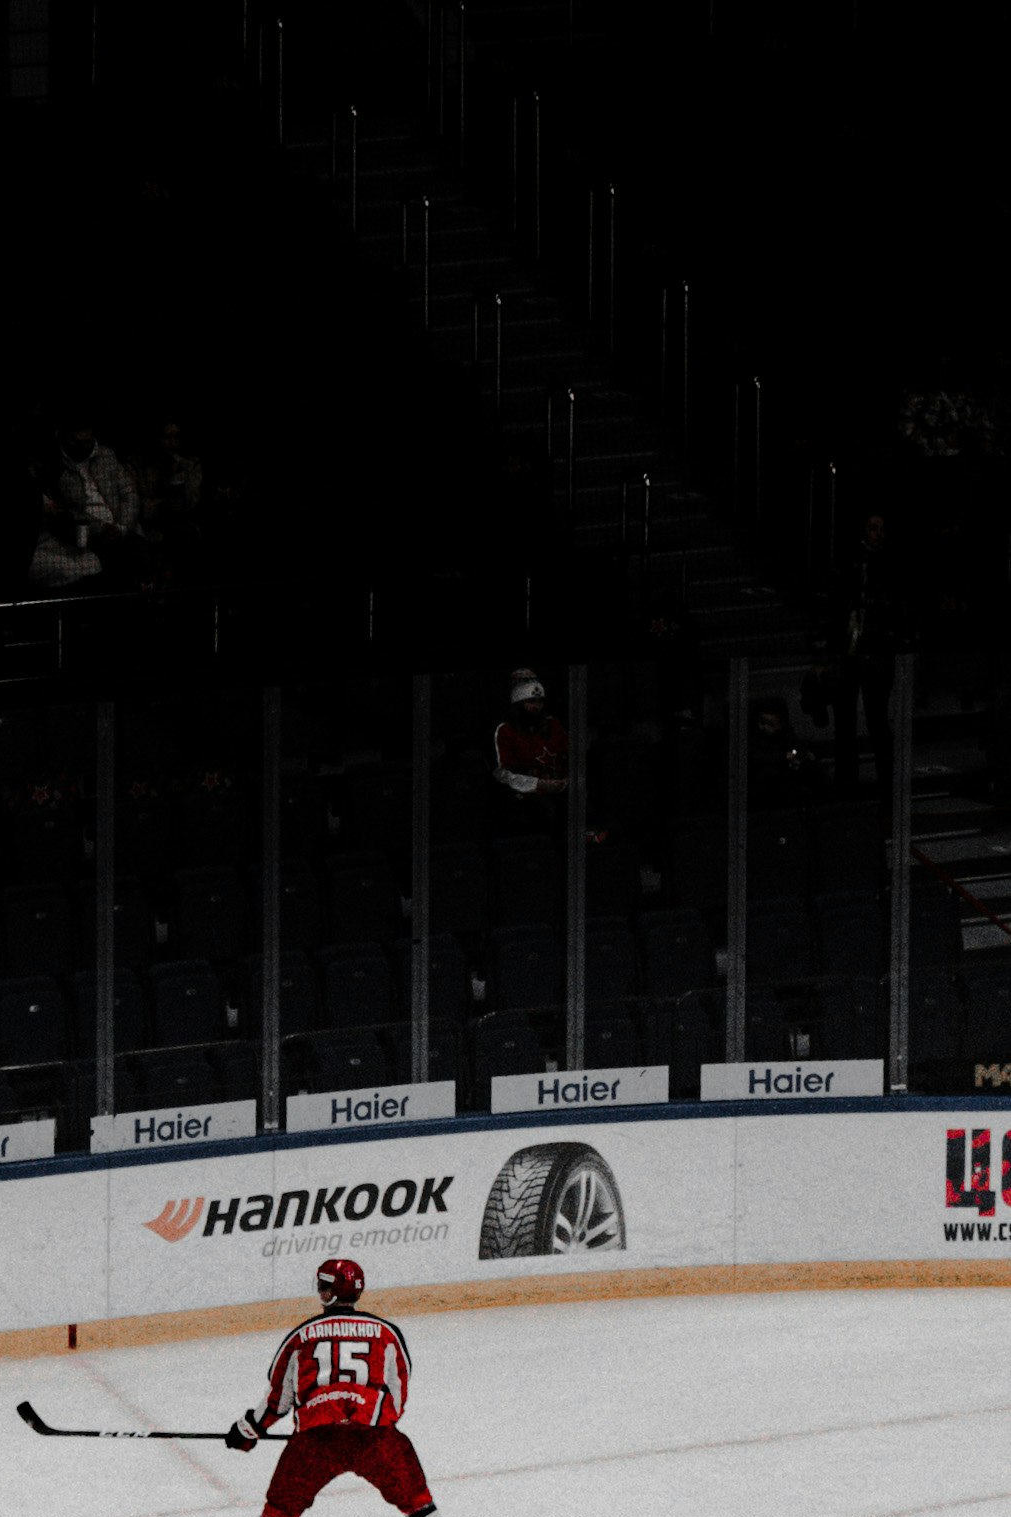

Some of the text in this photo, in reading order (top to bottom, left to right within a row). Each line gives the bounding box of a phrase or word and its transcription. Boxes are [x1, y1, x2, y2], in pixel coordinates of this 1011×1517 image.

[538, 1075, 621, 1105] Haier
[748, 1067, 835, 1094] Haier
[331, 1092, 410, 1124] Haier
[134, 1113, 213, 1144] Haier
[945, 1129, 1011, 1217] Ц
[261, 1222, 450, 1258] driving emotion
[299, 1322, 382, 1343] KARNAUKHOV
[313, 1341, 370, 1386] 15
